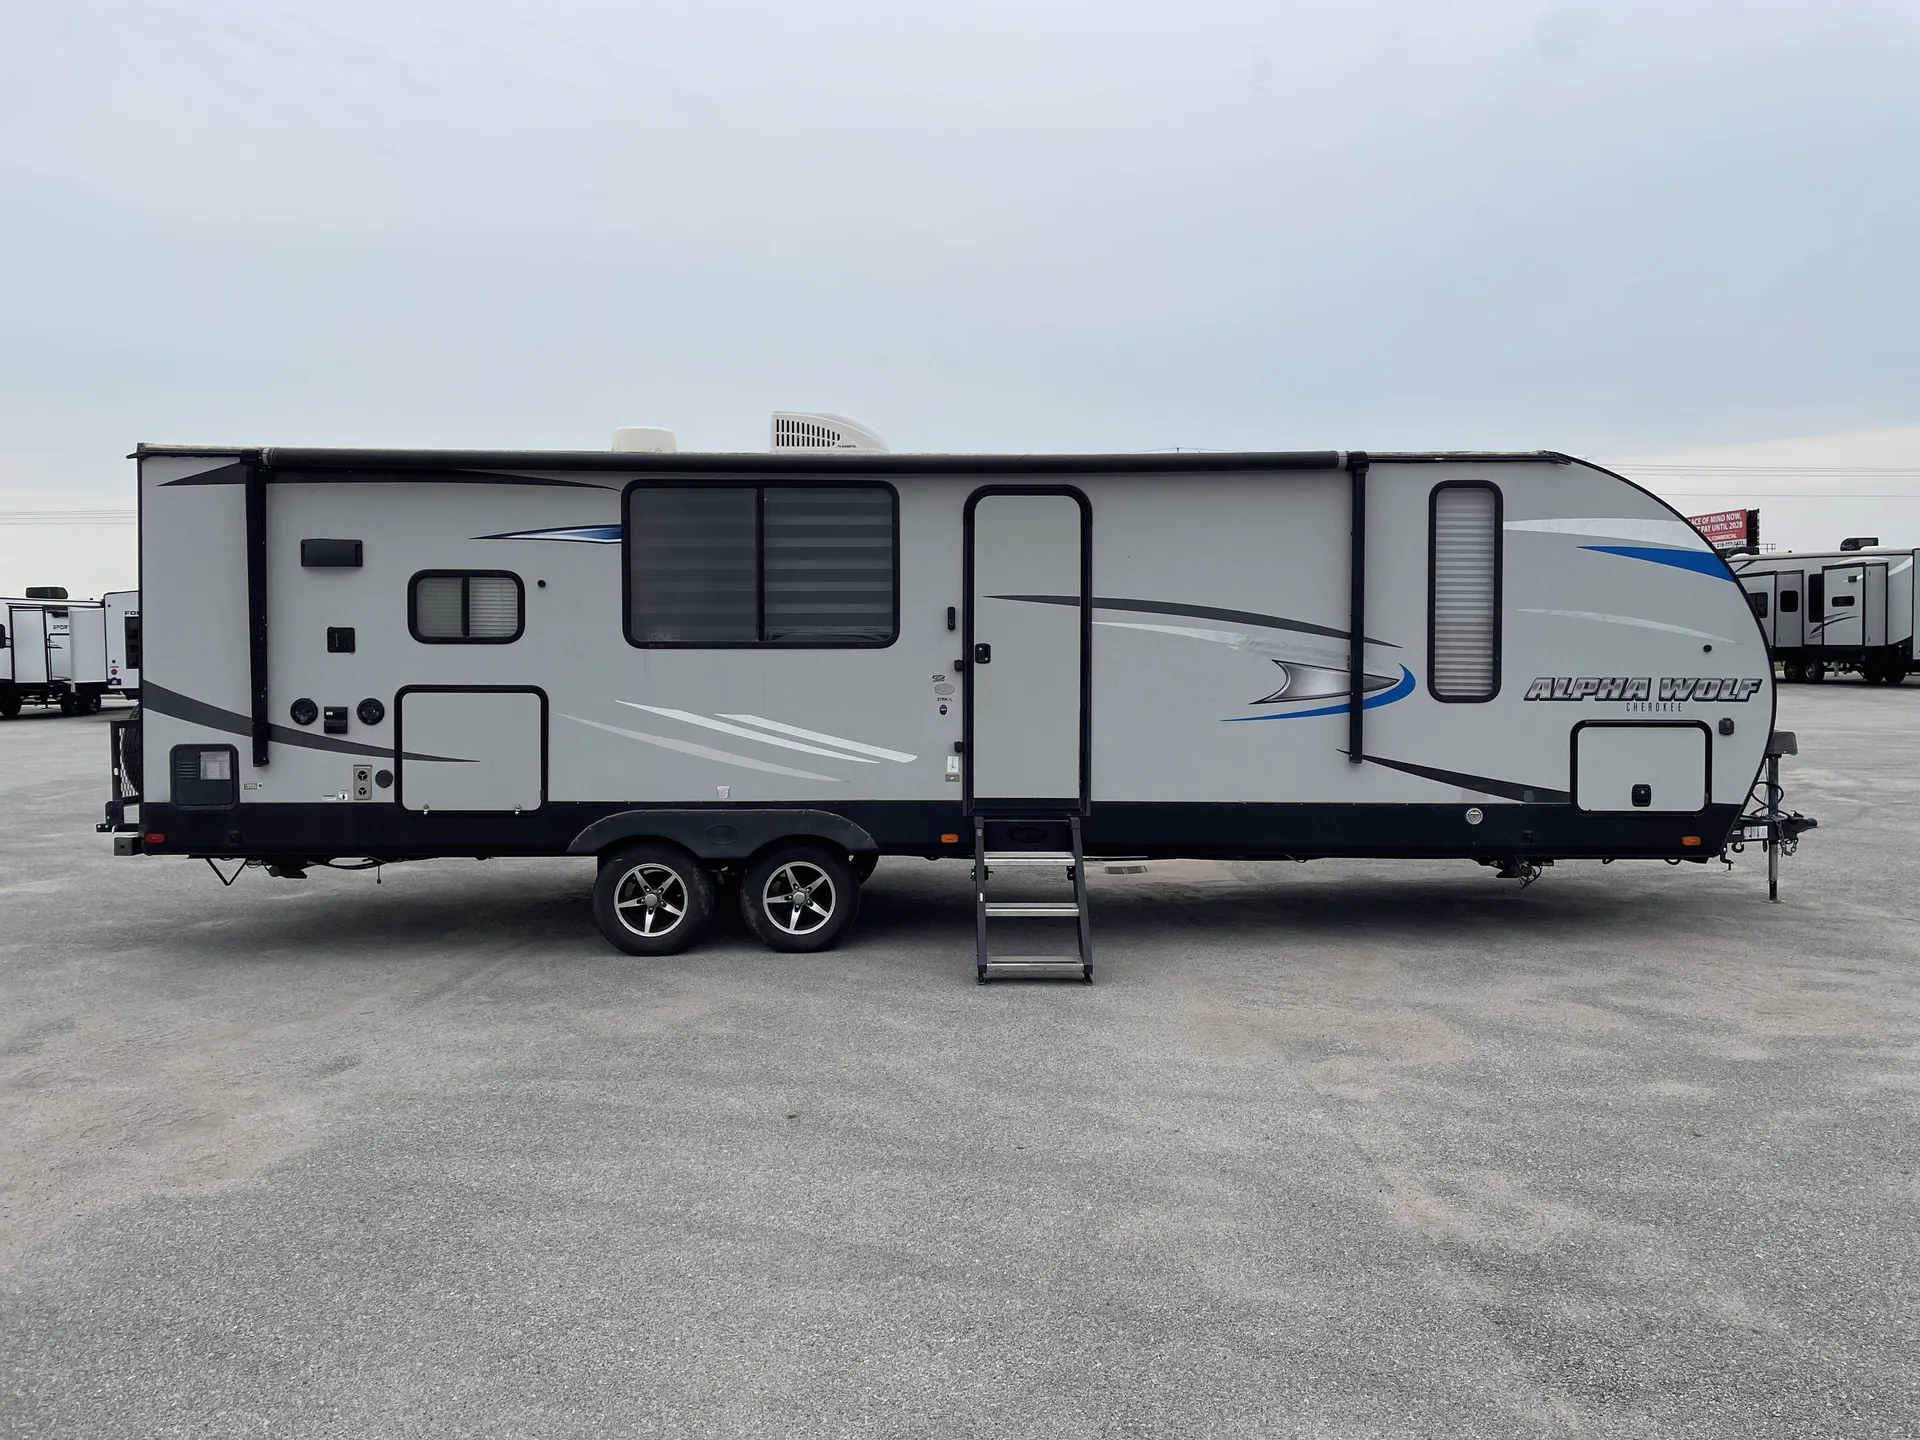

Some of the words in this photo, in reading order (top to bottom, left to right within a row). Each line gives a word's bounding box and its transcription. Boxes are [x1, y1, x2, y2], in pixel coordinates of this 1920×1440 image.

[1702, 516, 1710, 525] OF
[1710, 514, 1726, 523] MIND
[1726, 512, 1742, 521] NOW,
[1701, 524, 1711, 533] PAY
[1711, 522, 1728, 532] UNTIL
[1729, 521, 1743, 530] 2028
[1523, 677, 1651, 702] ALPHA
[1658, 677, 1763, 703] WOLF
[1626, 702, 1683, 712] CHEROKEE
